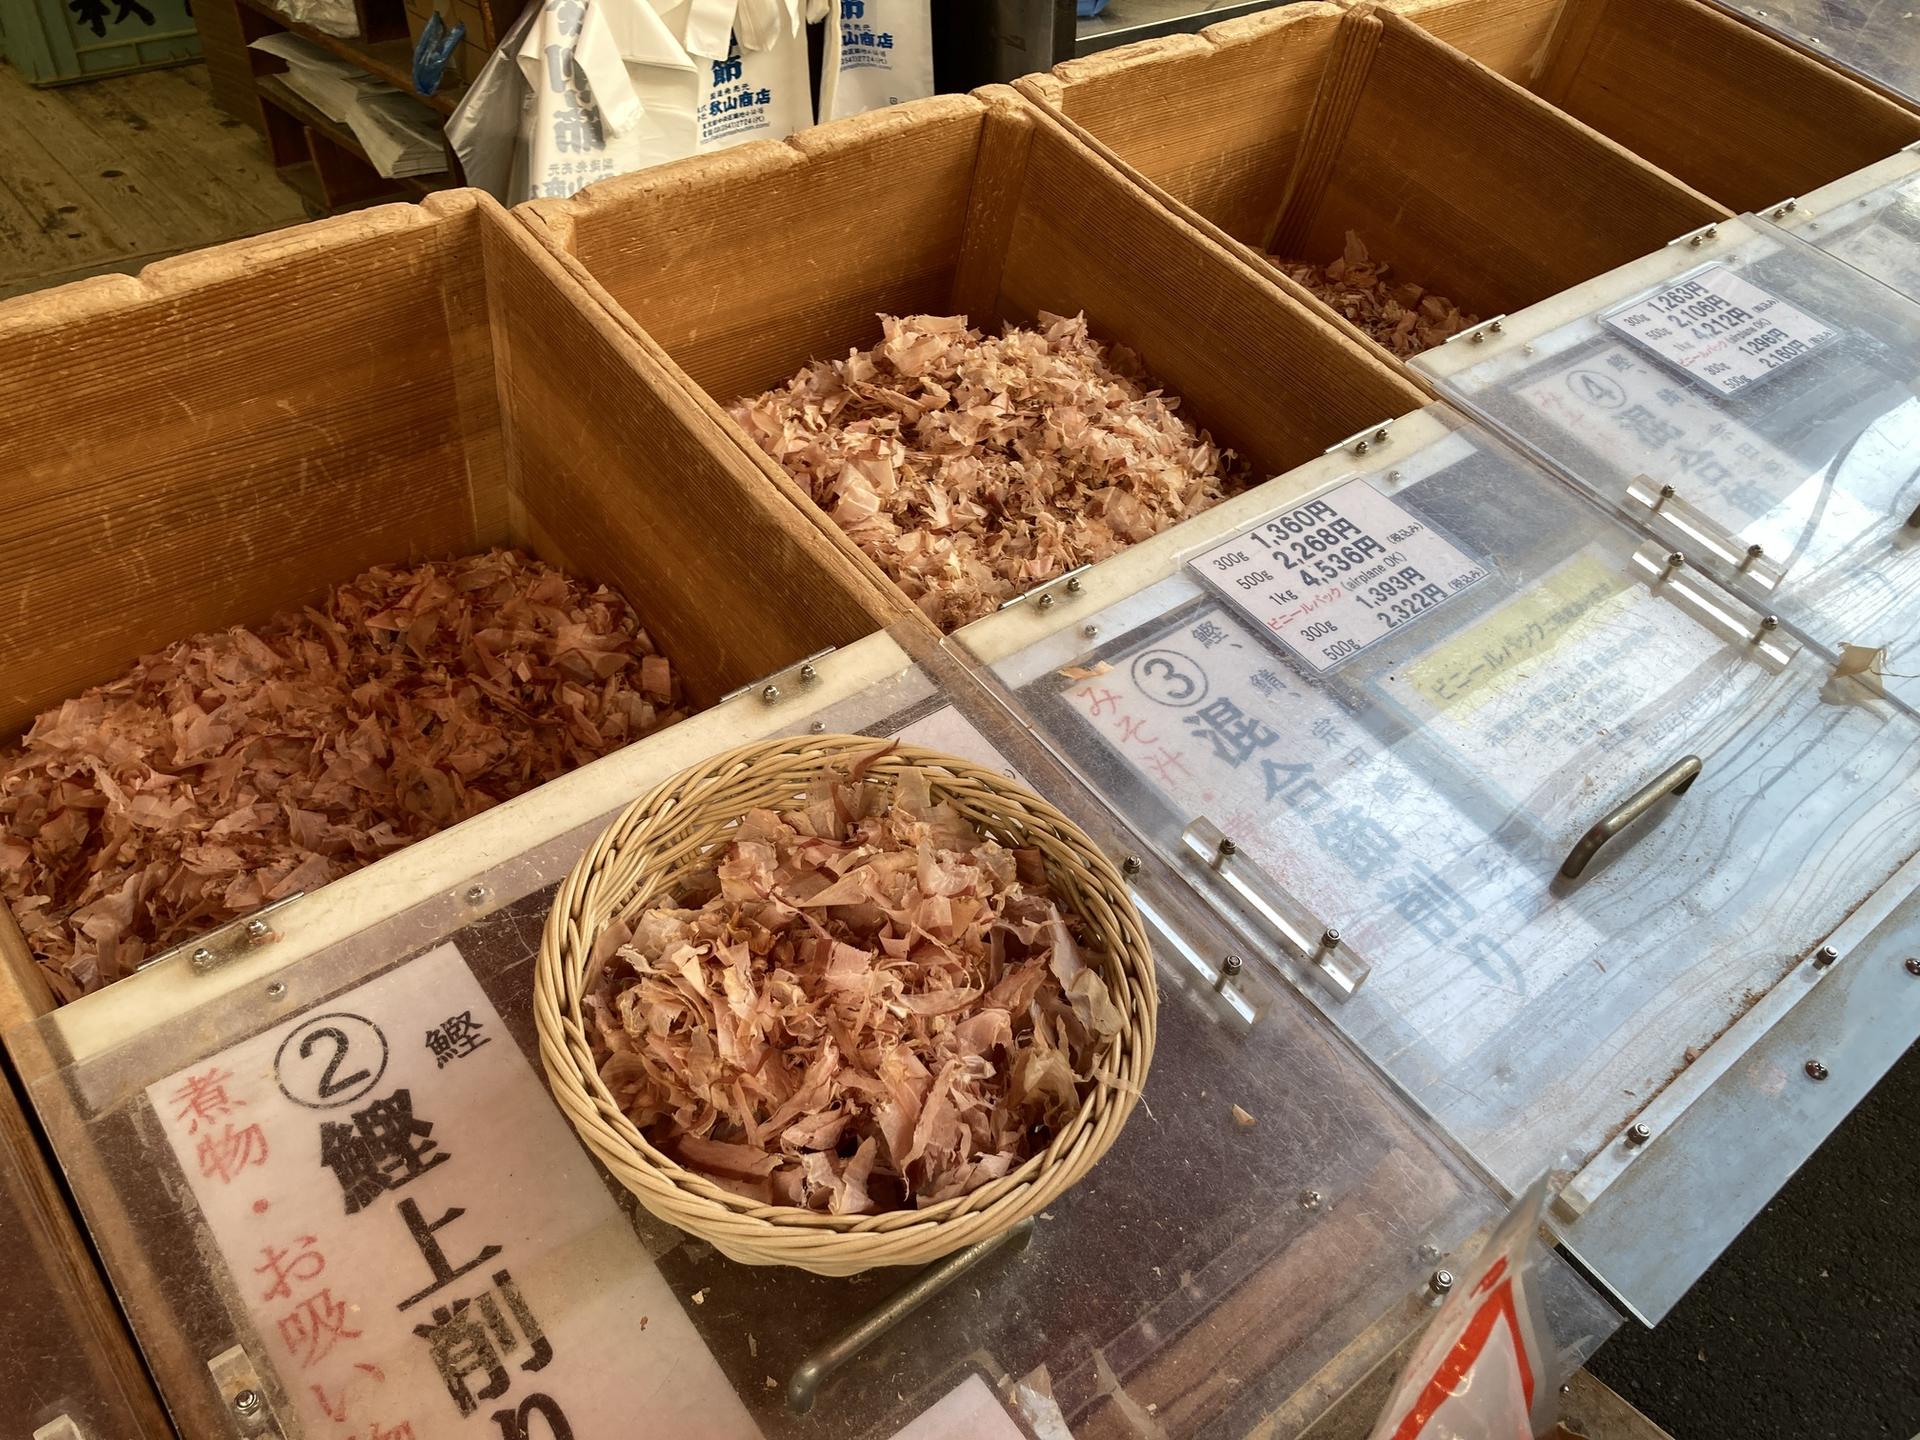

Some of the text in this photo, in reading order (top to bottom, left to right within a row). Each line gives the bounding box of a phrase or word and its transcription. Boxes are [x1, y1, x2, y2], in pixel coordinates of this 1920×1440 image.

[1624, 281, 1709, 327] 300g 1,263円
[1668, 294, 1731, 328] 2,106円
[1691, 307, 1754, 340] 4,212円
[1703, 328, 1789, 376] 300g 1,296円
[1722, 374, 1752, 390] 500g
[1758, 339, 1810, 370] 2,160円
[1213, 499, 1337, 571] 300g 1,360円
[1236, 517, 1362, 590] 500g 2,268円
[1269, 522, 1424, 606] 1kg 4,536円 (税込み)
[1268, 587, 1342, 631] ビニールパック
[1300, 566, 1426, 642] 300g 1,393円
[1323, 568, 1487, 661] 500g 2,322円 (税込み)
[424, 1010, 492, 1070] 鰹
